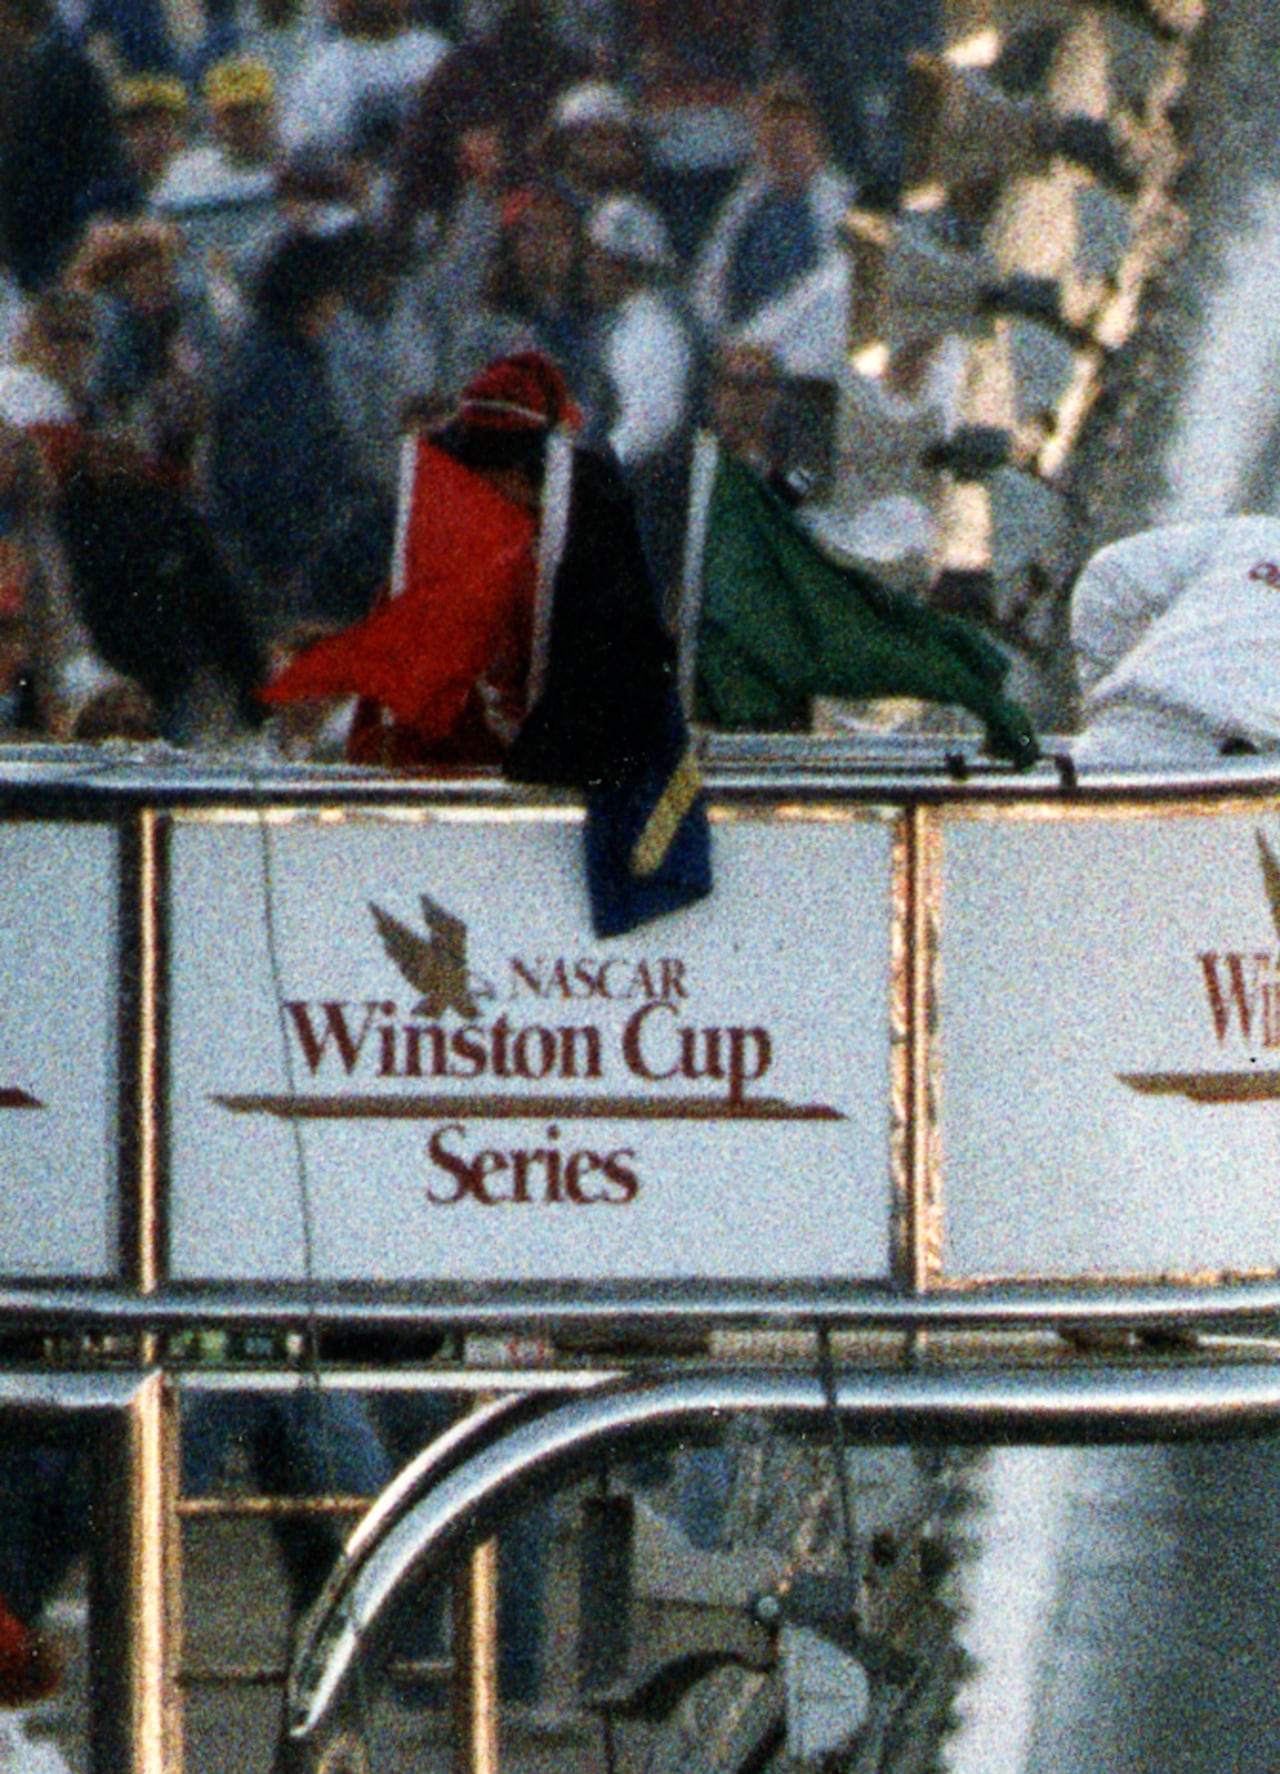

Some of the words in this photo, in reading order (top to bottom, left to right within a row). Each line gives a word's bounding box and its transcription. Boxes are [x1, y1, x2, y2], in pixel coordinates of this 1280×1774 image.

[508, 956, 690, 1001] NASCAR
[283, 999, 603, 1080] Winston
[621, 1000, 774, 1106] Cup
[426, 1124, 640, 1206] Series
